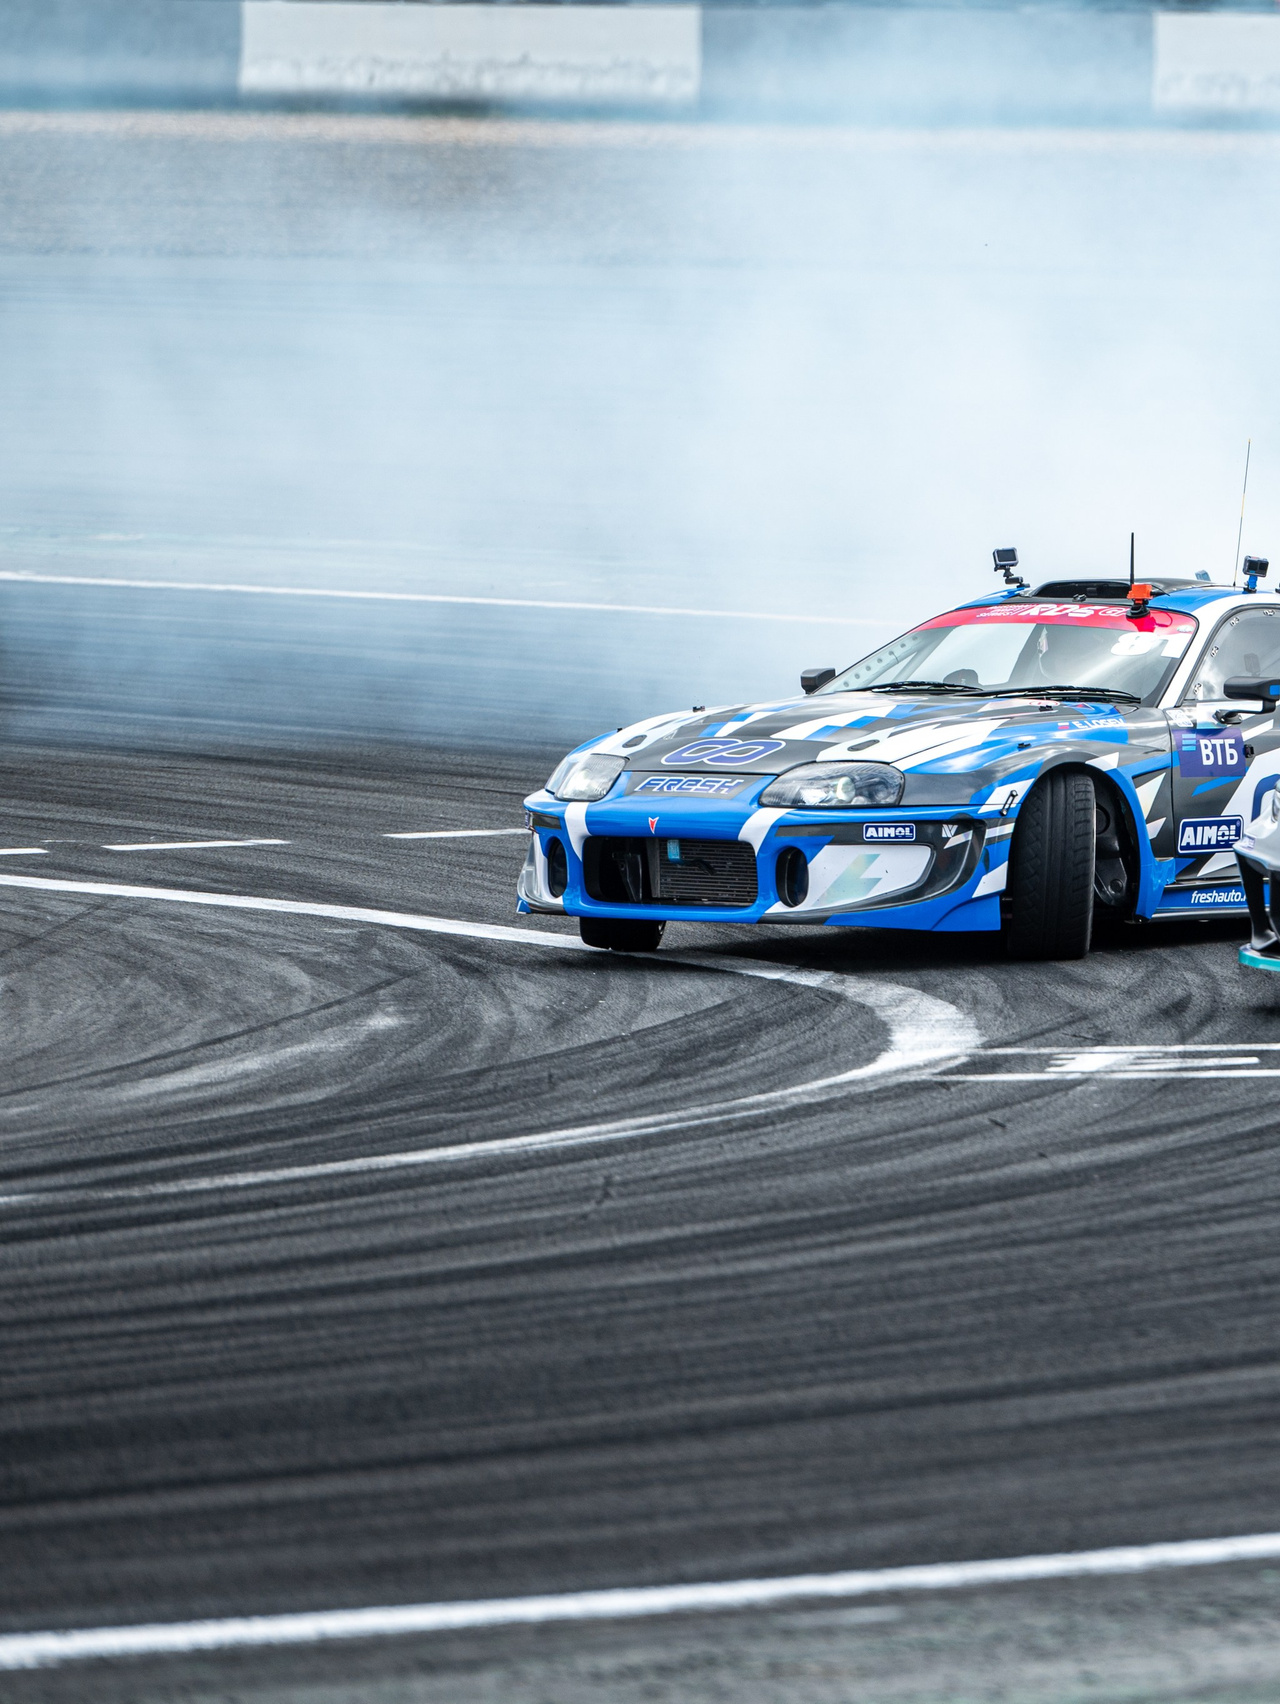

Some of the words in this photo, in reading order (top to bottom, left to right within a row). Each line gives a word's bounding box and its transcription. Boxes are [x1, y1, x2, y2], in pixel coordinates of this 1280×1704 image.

[1018, 604, 1107, 618] RDS
[1111, 631, 1192, 658] 81
[1199, 738, 1239, 766] ВТБ
[634, 776, 745, 795] FRESH
[865, 826, 914, 838] AIMOL
[1180, 824, 1240, 847] AIMOL
